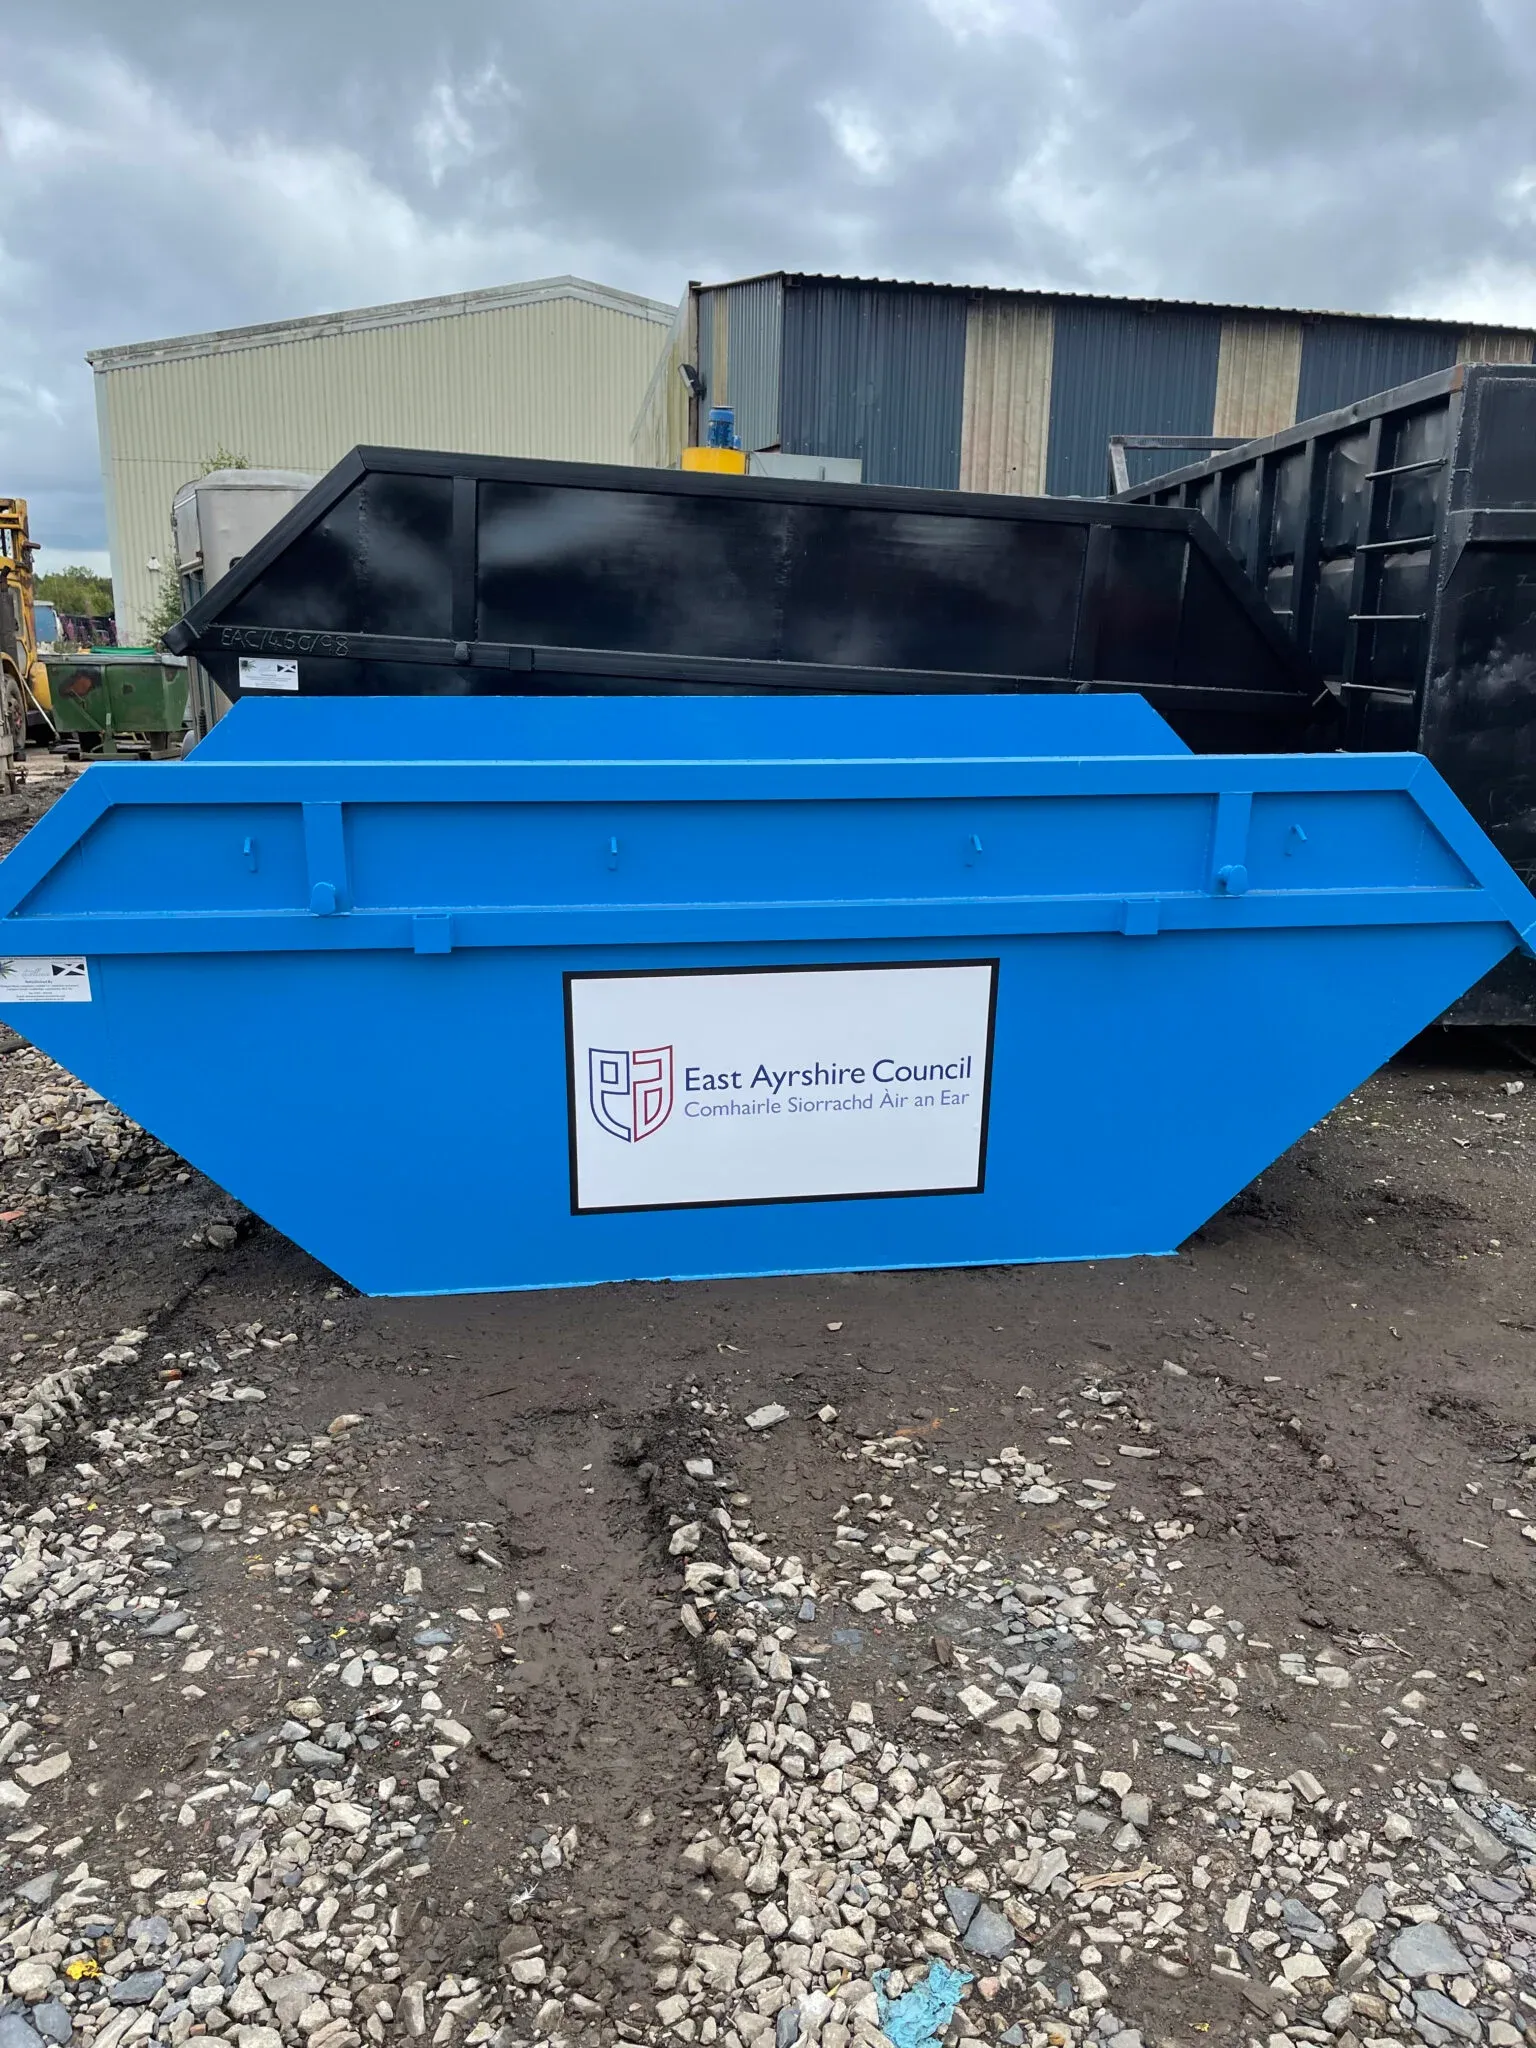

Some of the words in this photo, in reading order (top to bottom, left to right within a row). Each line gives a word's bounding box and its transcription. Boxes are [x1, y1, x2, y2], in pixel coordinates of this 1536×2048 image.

[685, 1067, 742, 1091] East
[750, 1061, 865, 1095] Ayrshire
[872, 1055, 972, 1083] Council
[684, 1098, 781, 1117] Comhairle
[787, 1093, 873, 1113] Siorrachd
[879, 1088, 909, 1108] Àir
[914, 1095, 935, 1107] an
[940, 1089, 970, 1106] Ear
